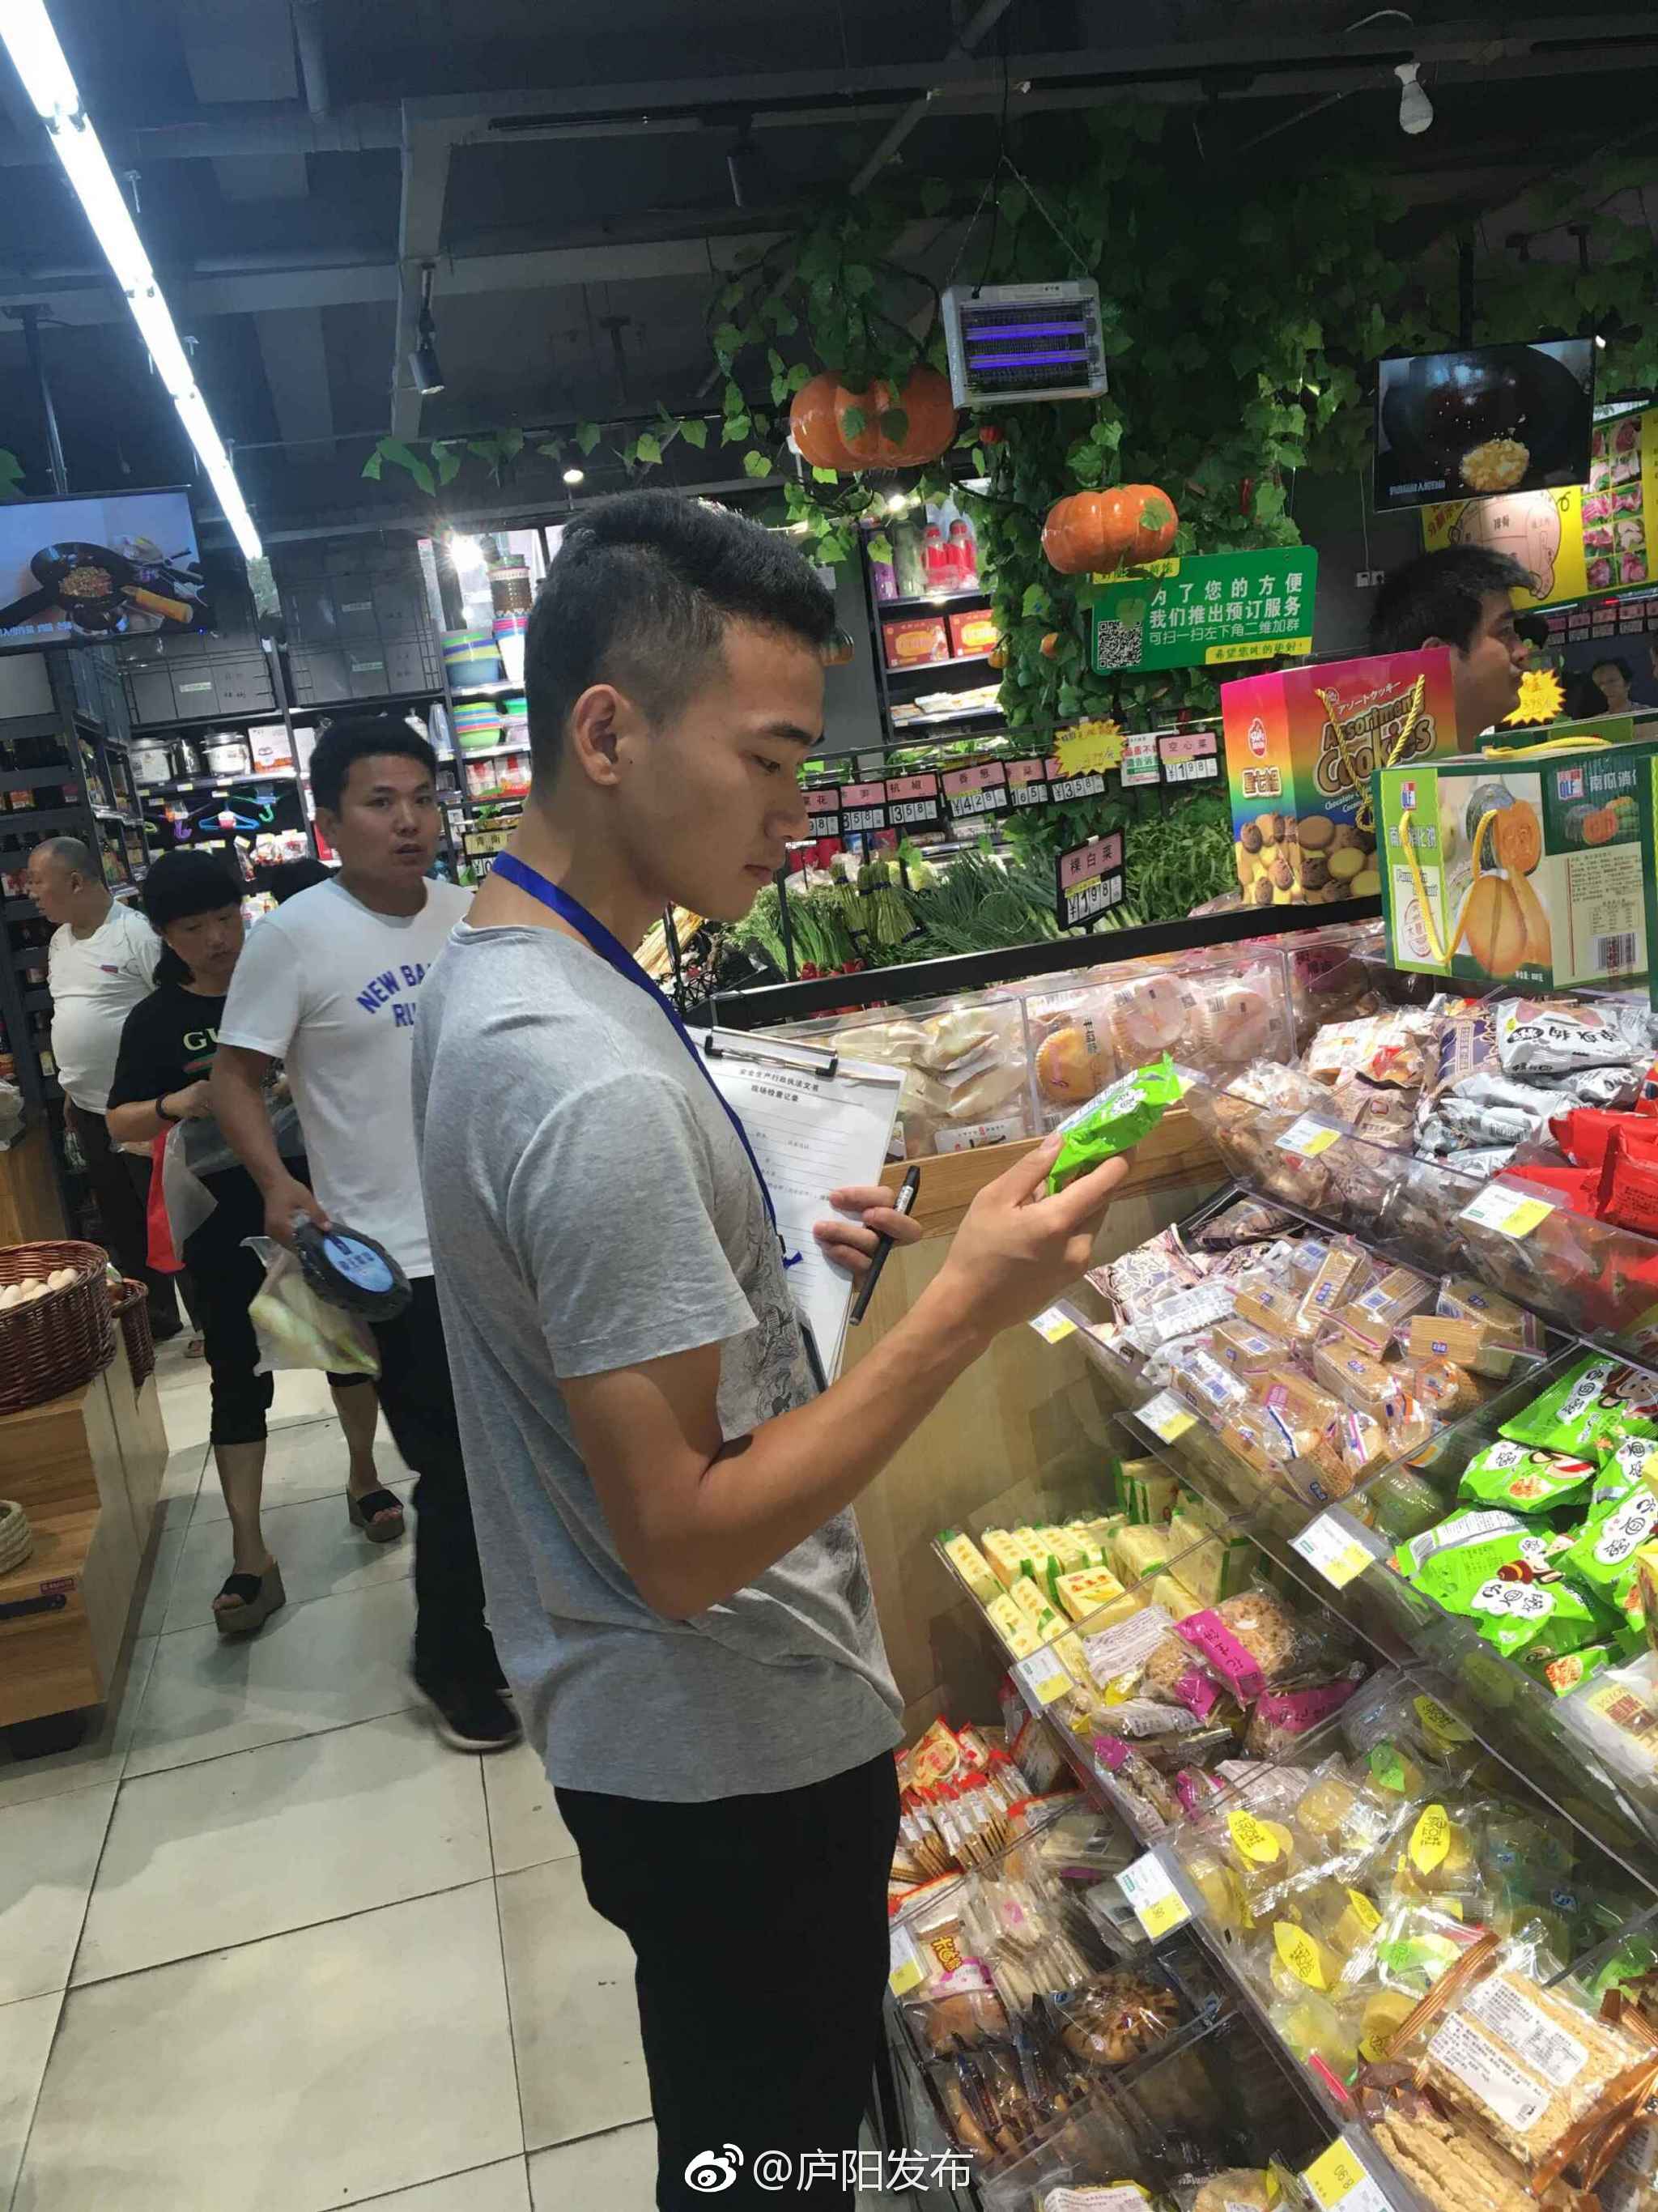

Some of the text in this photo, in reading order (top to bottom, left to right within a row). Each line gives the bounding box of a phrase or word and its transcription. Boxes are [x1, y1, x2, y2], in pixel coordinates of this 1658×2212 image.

[1150, 572, 1303, 607] 为了您的方便
[1149, 595, 1302, 630] 我们推出预订服务
[356, 963, 431, 1014] NEW BA
